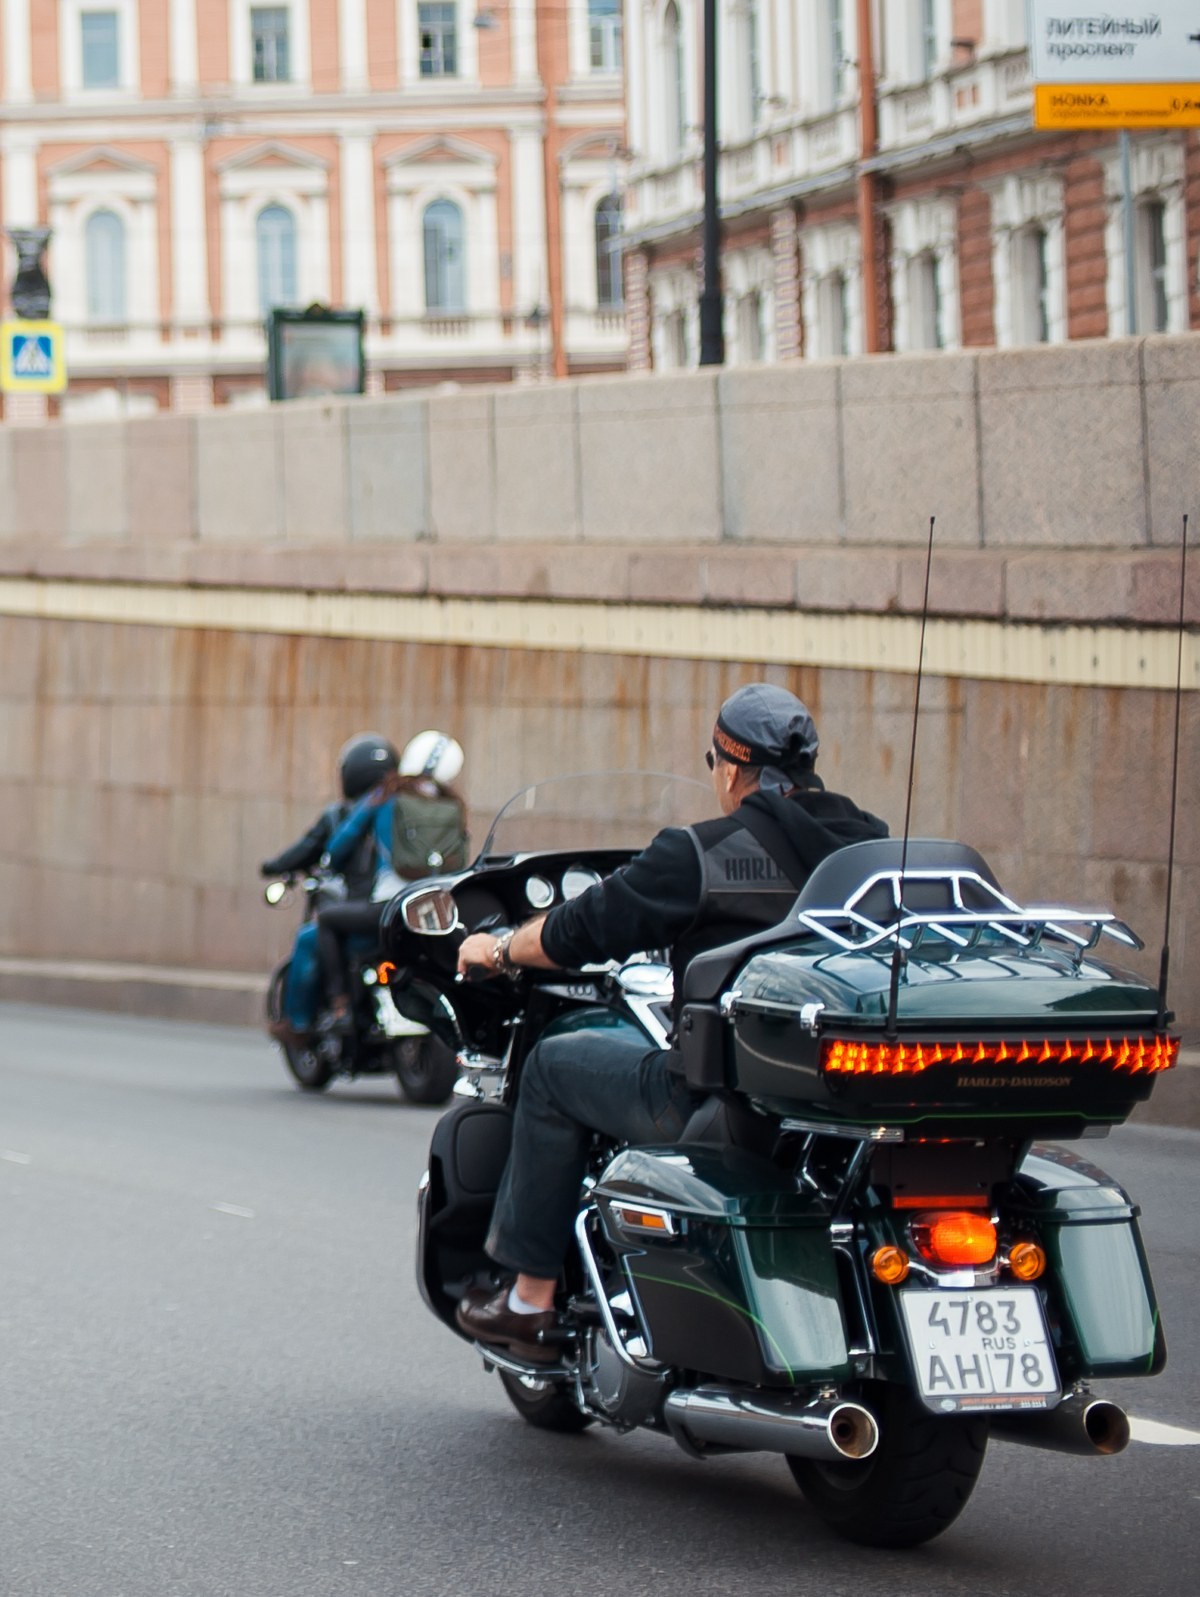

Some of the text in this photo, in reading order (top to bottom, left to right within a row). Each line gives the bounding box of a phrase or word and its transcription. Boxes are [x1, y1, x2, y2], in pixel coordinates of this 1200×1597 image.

[1046, 13, 1162, 36] ЛИТЕЙНЫЙ
[1047, 43, 1136, 61] проспект
[956, 1076, 1073, 1088] HARLEY-DAVIDSON
[927, 1300, 1022, 1337] 4783
[982, 1337, 1017, 1350] RUS
[928, 1352, 1044, 1391] AH 78
